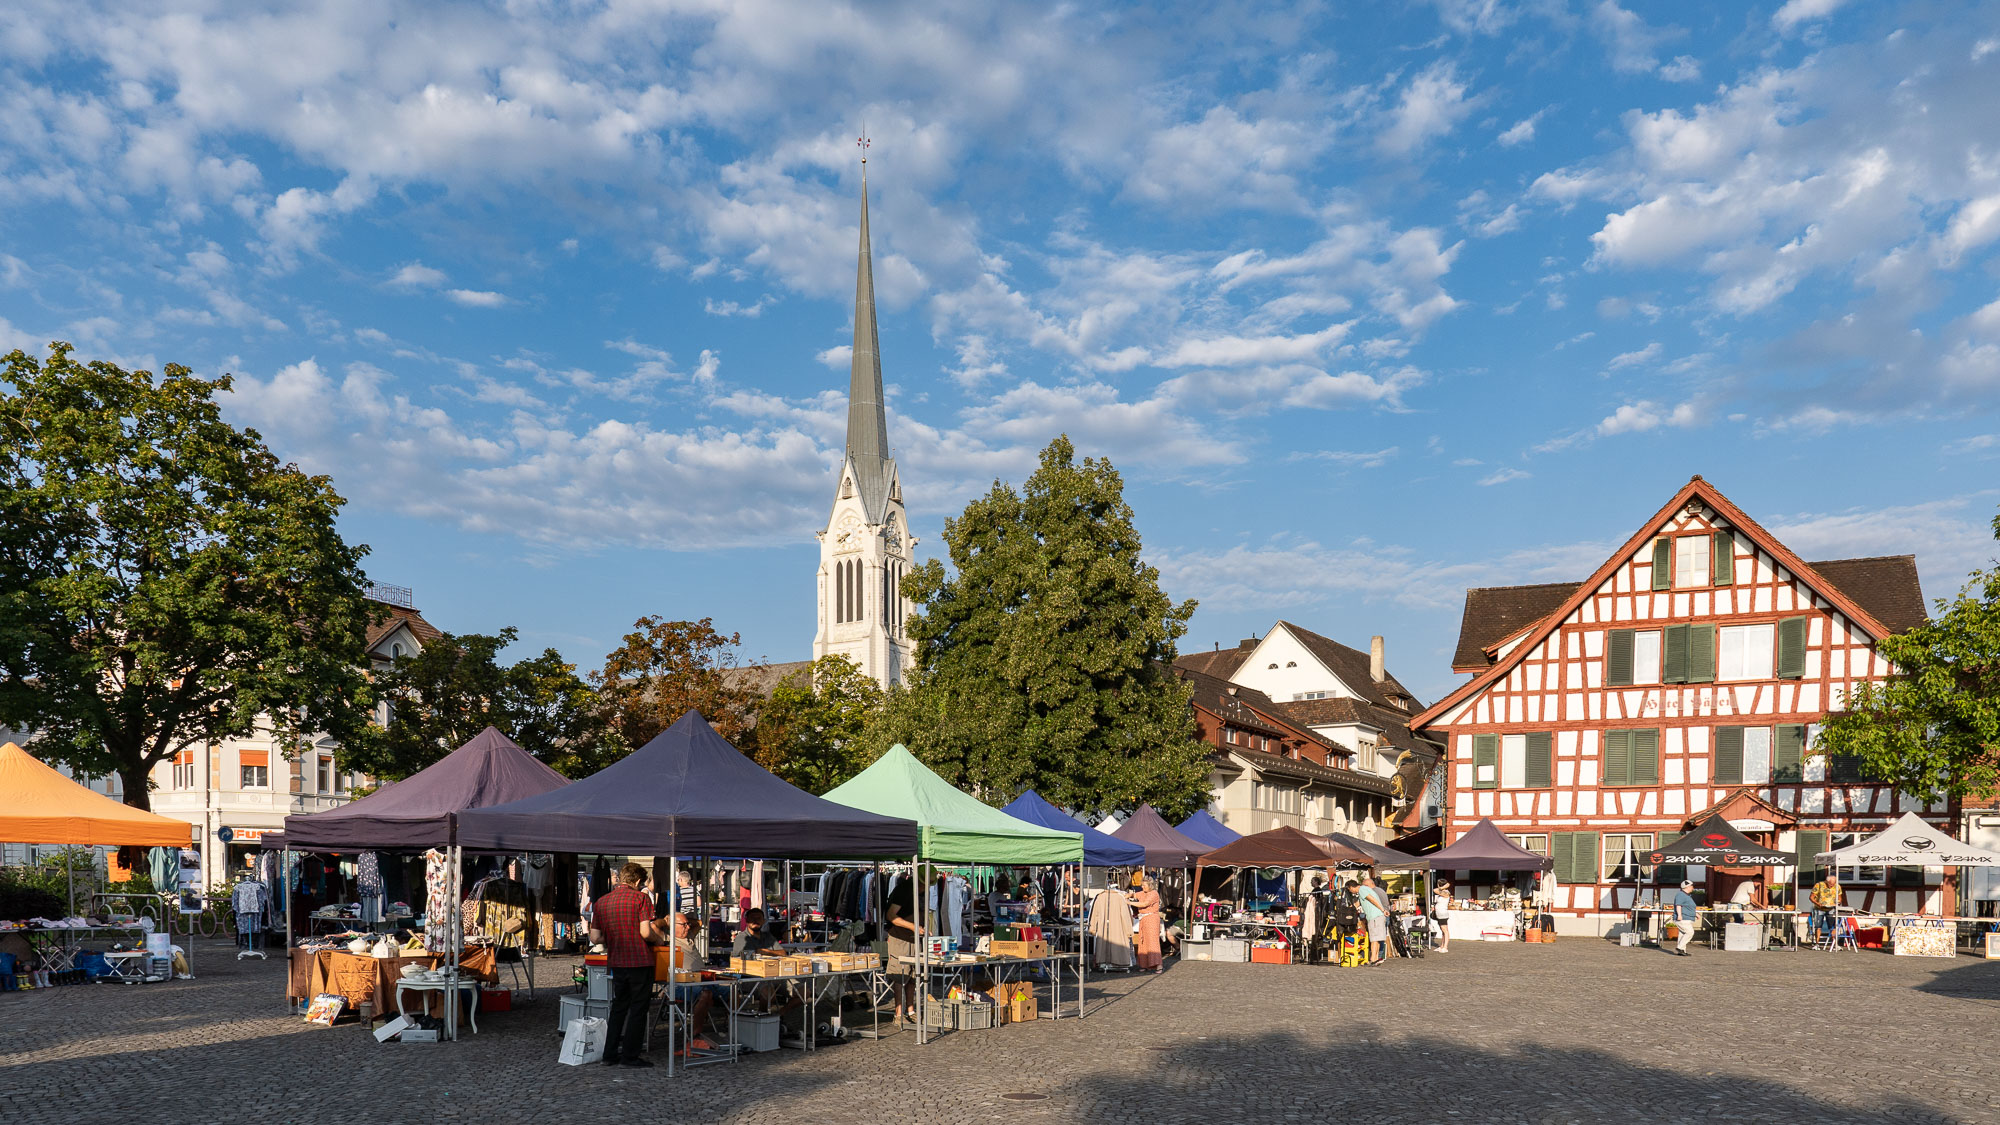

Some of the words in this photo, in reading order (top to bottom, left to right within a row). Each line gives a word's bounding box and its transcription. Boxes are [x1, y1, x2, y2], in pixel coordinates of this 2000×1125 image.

[236, 829, 273, 839] Fus
[1664, 855, 1711, 863] 24MX
[1739, 856, 1787, 864] 24MX
[1953, 855, 1993, 863] 24MX
